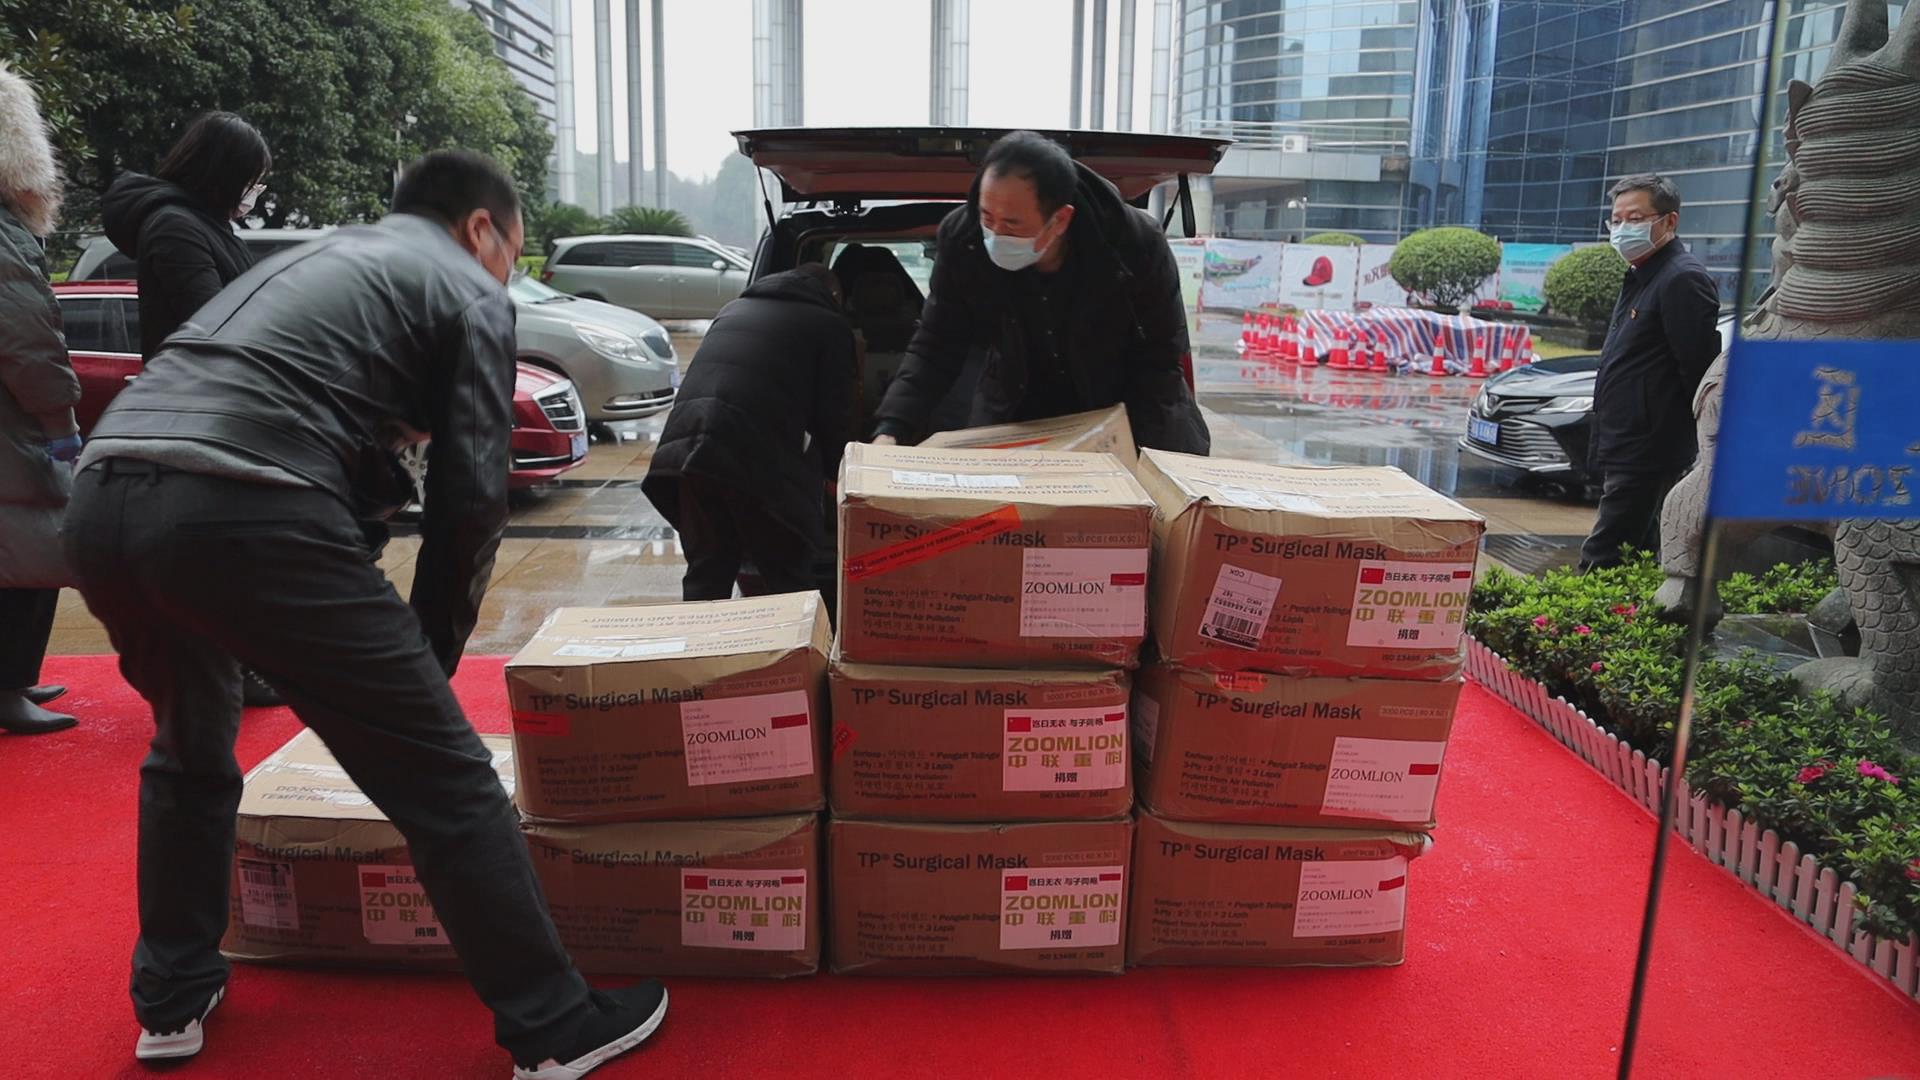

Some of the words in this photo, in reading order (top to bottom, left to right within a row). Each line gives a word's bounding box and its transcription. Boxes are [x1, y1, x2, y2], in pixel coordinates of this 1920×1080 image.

[992, 530, 1046, 547] Mask
[1252, 538, 1335, 560] Surgical
[1338, 541, 1386, 560] Mask
[1024, 582, 1105, 594] ZOOMLION
[1358, 589, 1467, 607] ZOOMLION
[566, 690, 646, 712] Surgical
[652, 687, 704, 705] Mask
[888, 689, 967, 708] Surgical
[974, 688, 1028, 706] Mask
[1231, 696, 1306, 719] Surgical
[1312, 701, 1362, 720] Mask
[687, 727, 767, 745] ZOOMLION
[1008, 734, 1123, 752] ZOOMLION
[1331, 768, 1404, 783] ZOOMLION
[254, 842, 329, 864] Surgical
[571, 850, 648, 868] Surgical
[1195, 844, 1269, 861] Surgical
[1275, 845, 1325, 861] Mask
[893, 853, 970, 872] Surgical
[977, 854, 1029, 870] Mask
[686, 894, 802, 911] ZOOMLION
[1005, 893, 1119, 910] ZOOMLION
[1301, 889, 1373, 902] ZOOMLION
